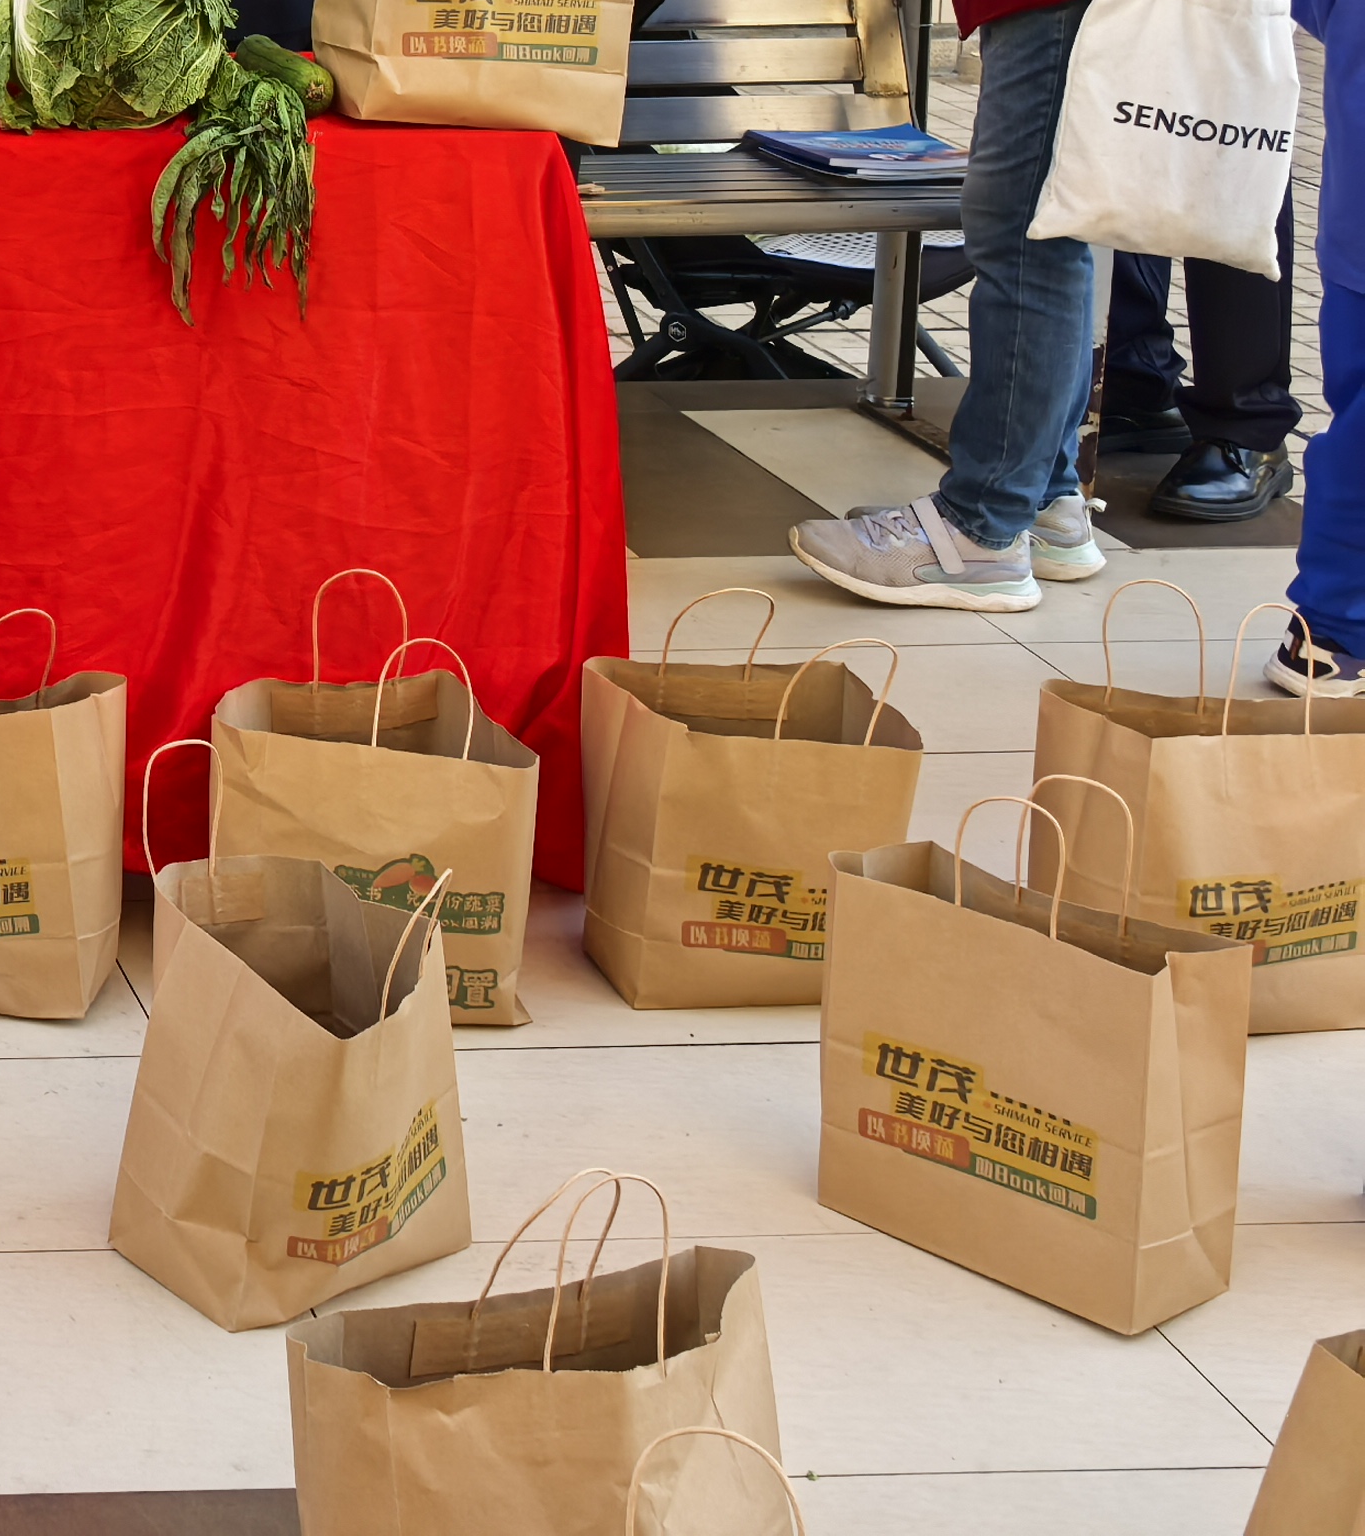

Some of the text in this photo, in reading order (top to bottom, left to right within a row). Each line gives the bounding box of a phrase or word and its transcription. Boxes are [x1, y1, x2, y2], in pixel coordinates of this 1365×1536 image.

[433, 9, 598, 36] 美好与您相遇
[1113, 101, 1291, 153] SENSODYNE
[697, 862, 794, 904] 世茂
[1189, 879, 1273, 918] 世茂
[875, 1042, 977, 1104] 世茂
[894, 1090, 1094, 1182] 美好与您相遇
[1043, 1121, 1093, 1149] SERVICE
[307, 1154, 393, 1211] 世茂
